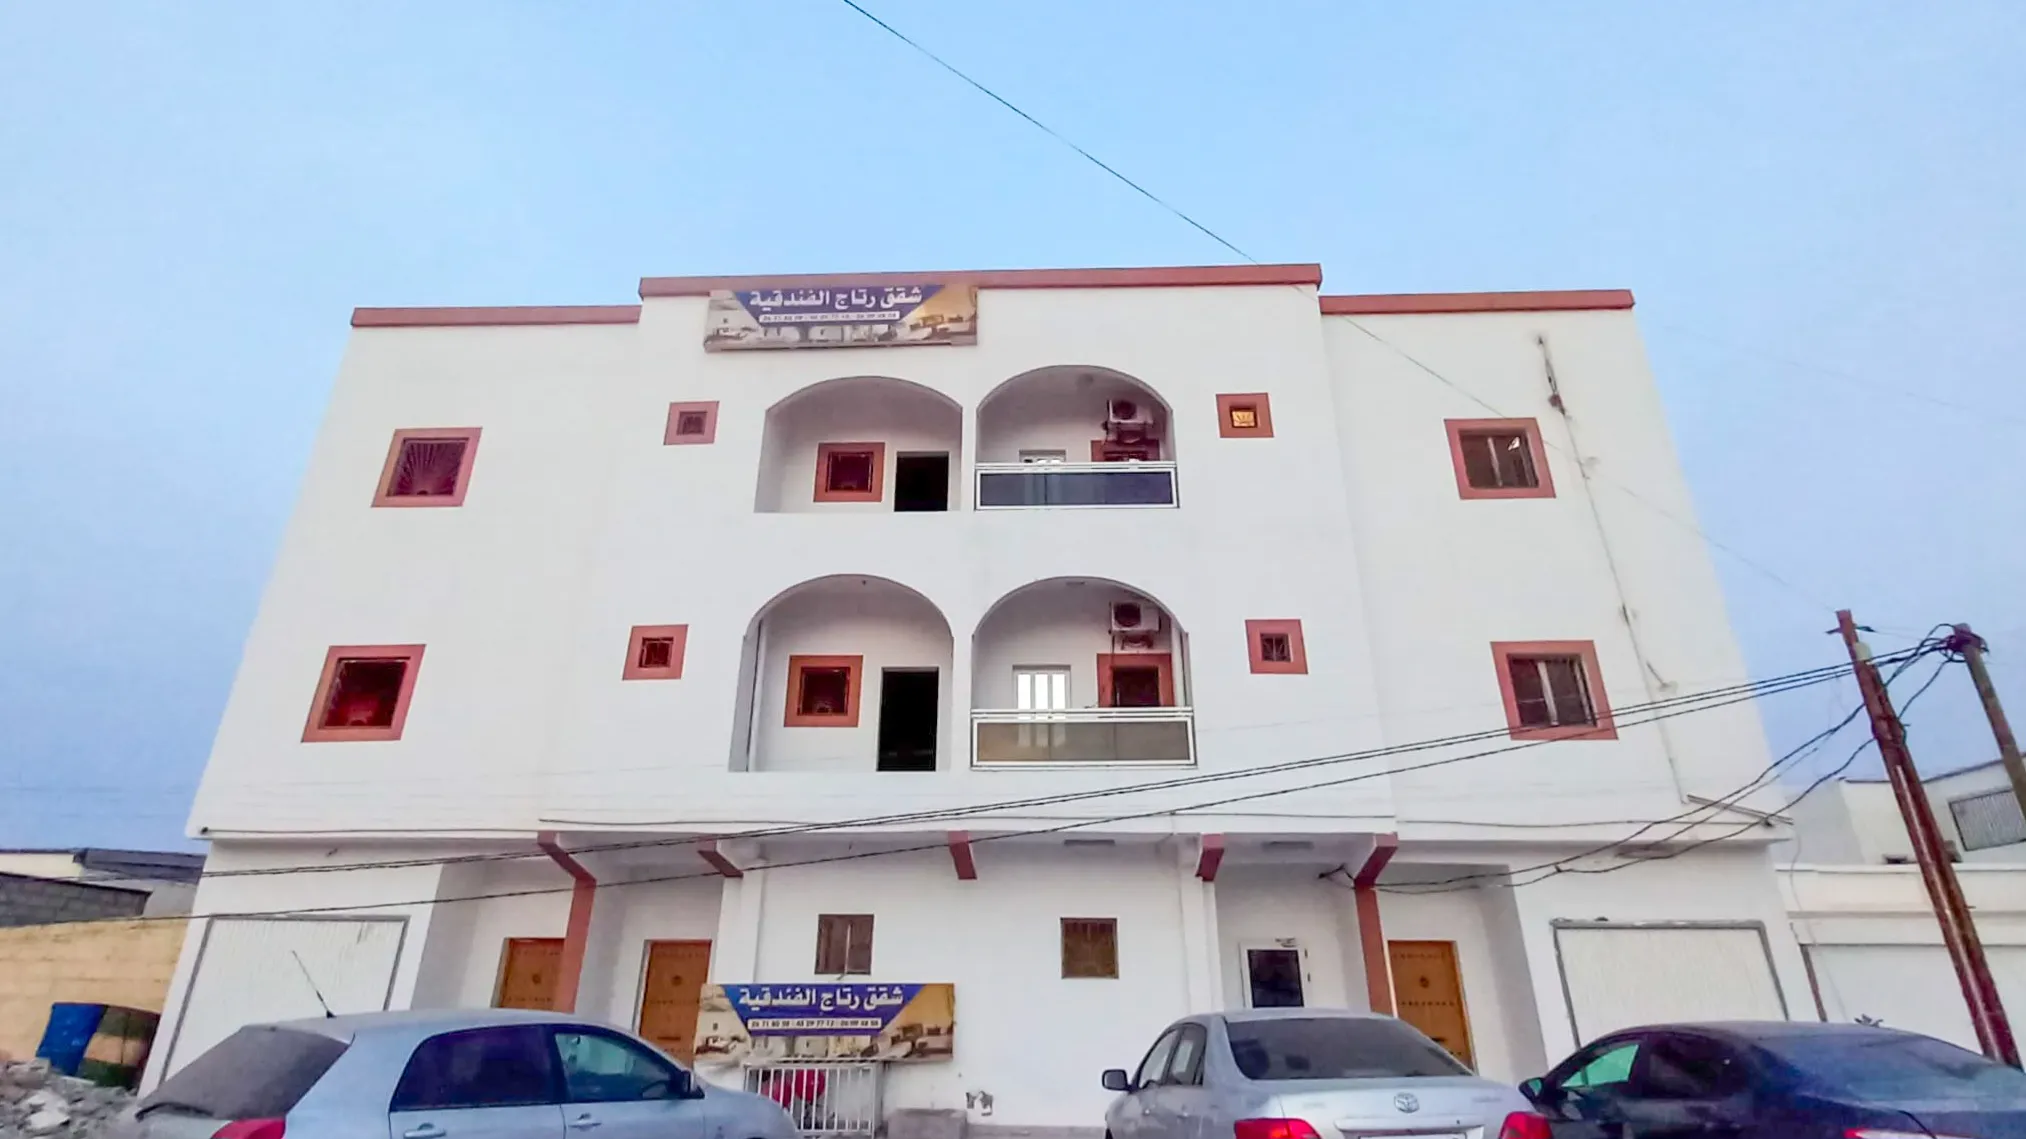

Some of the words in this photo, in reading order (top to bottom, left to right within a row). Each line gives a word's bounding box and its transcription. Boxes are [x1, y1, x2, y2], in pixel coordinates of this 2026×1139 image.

[750, 289, 830, 311] الفندقية
[834, 288, 876, 310] رتاج
[880, 286, 923, 309] شقق
[739, 986, 817, 1011] الفندقية
[820, 987, 860, 1011] رتاج
[863, 986, 904, 1010] شقق
